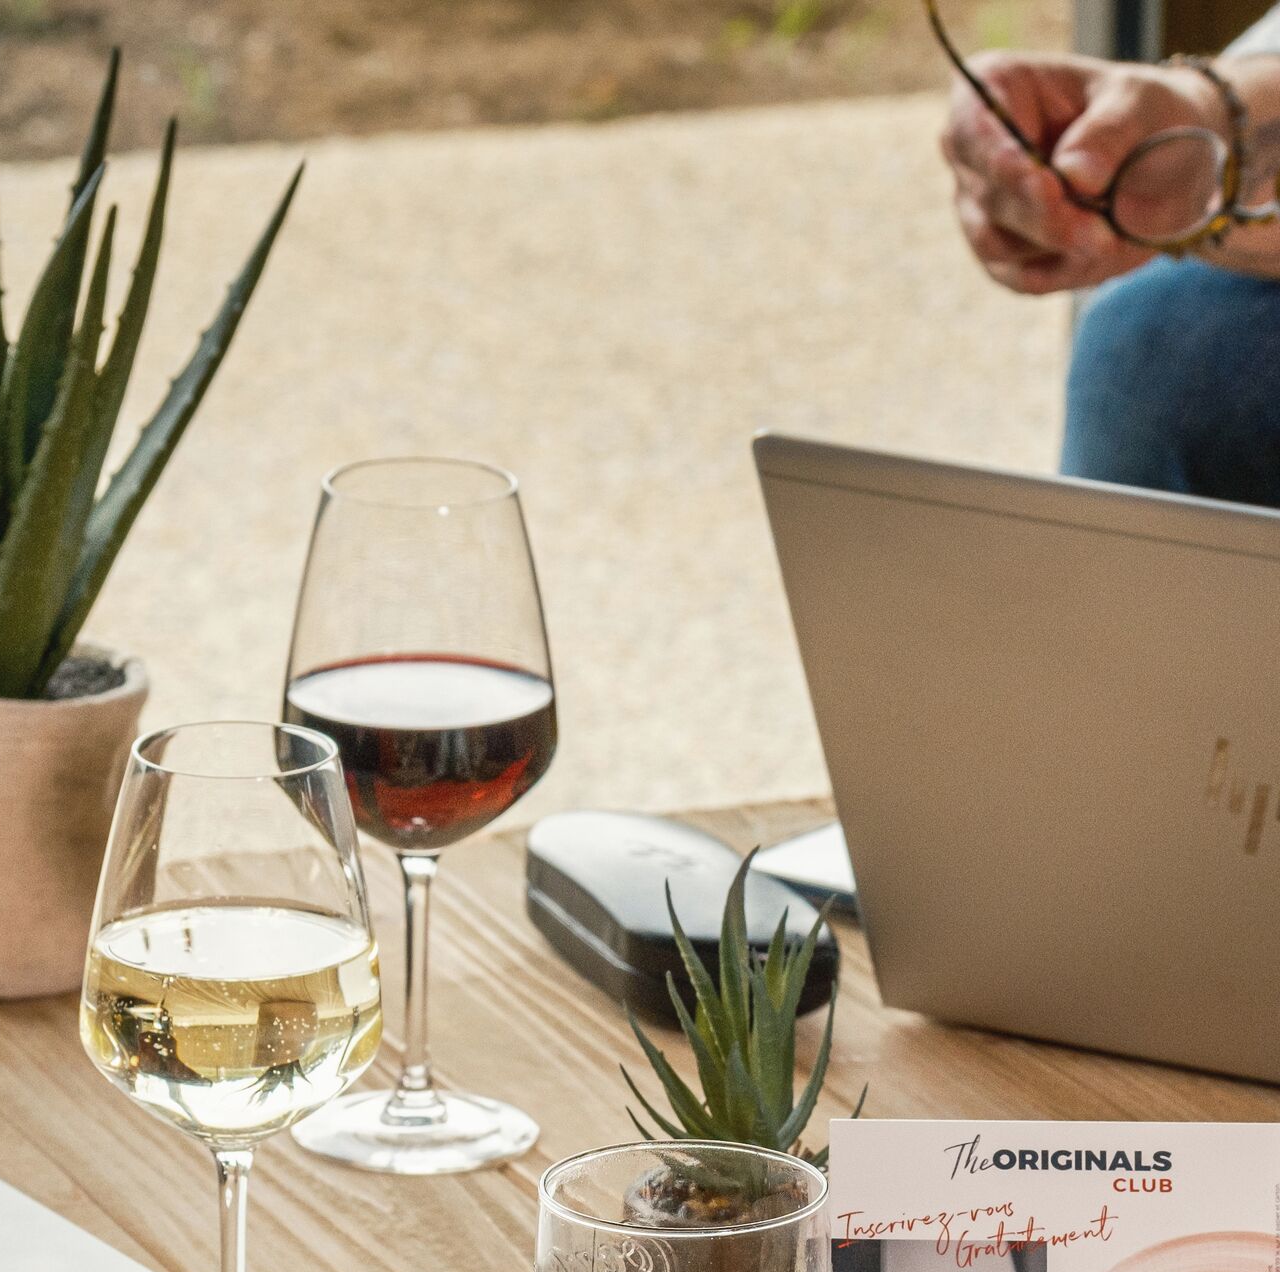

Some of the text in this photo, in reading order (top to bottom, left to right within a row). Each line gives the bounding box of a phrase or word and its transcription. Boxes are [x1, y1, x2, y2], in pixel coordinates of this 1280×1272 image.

[944, 1134, 1173, 1180] The ORIGINALS
[1112, 1178, 1173, 1193] CLUB
[837, 1201, 1014, 1255] Inscrivez-vous
[956, 1205, 1118, 1268] Gratuitement
